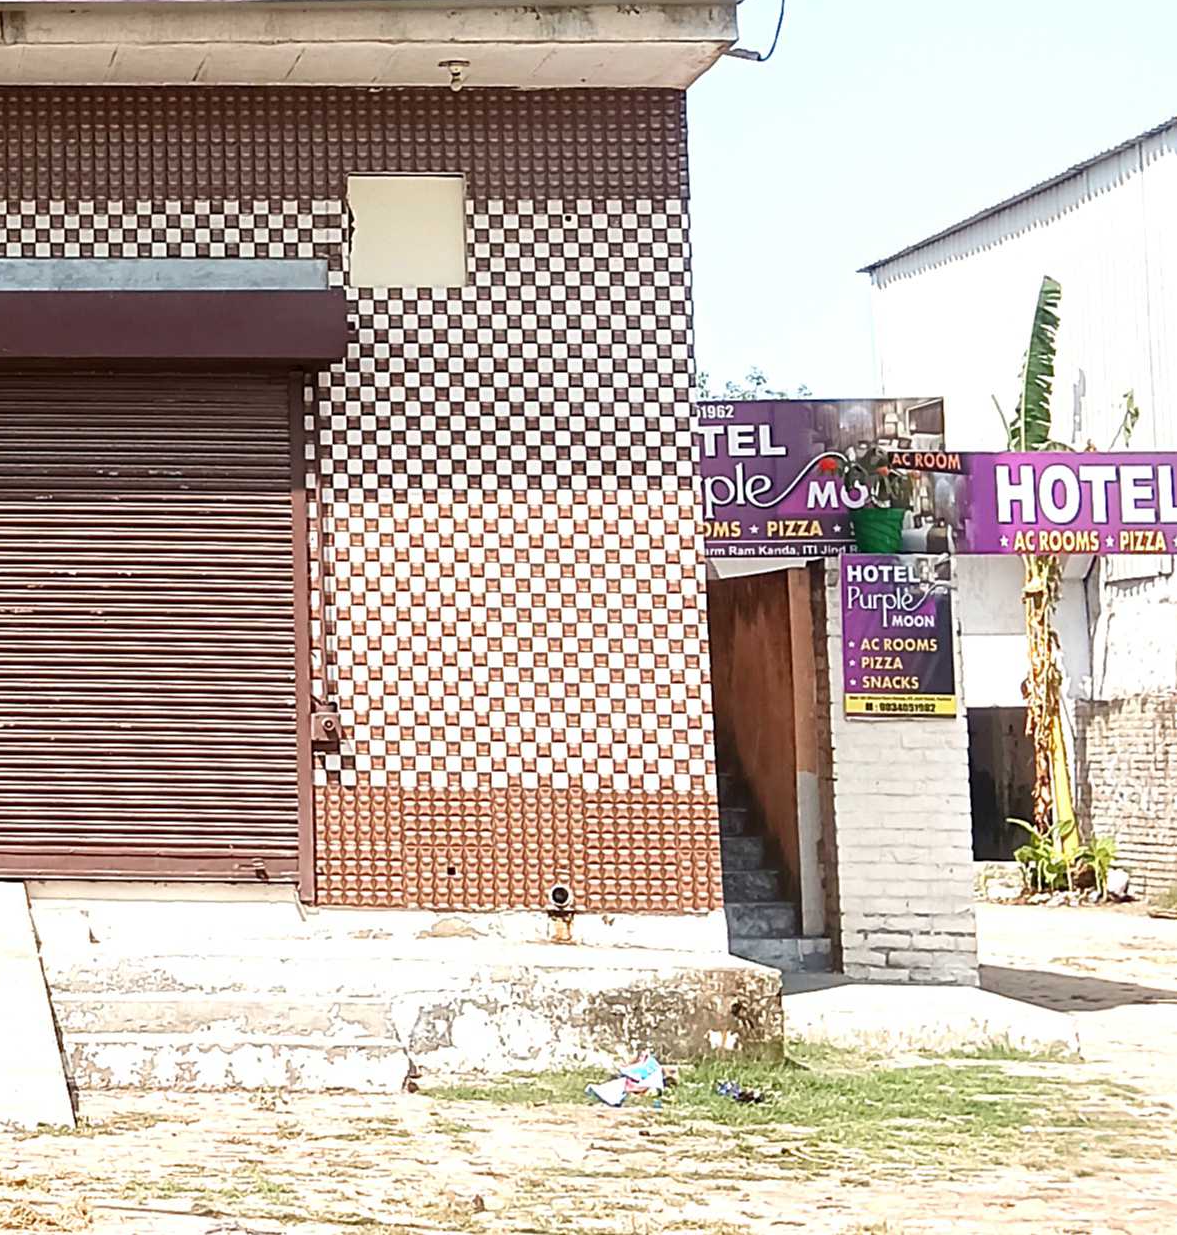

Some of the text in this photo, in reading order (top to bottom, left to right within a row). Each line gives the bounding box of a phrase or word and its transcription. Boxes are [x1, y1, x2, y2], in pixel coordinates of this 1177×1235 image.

[891, 453, 961, 470] AC ROOM
[766, 520, 824, 537] PIZZA
[1013, 530, 1167, 552] AC ROOMS PIZZA
[729, 545, 756, 556] Ram
[758, 545, 801, 557] Kanda,
[846, 564, 921, 583] HOTEL
[847, 586, 922, 628] Purple
[891, 615, 935, 627] MOON
[860, 638, 938, 652] AC ROOMS
[861, 657, 904, 670] PIZZA
[862, 676, 920, 689] SNACKS
